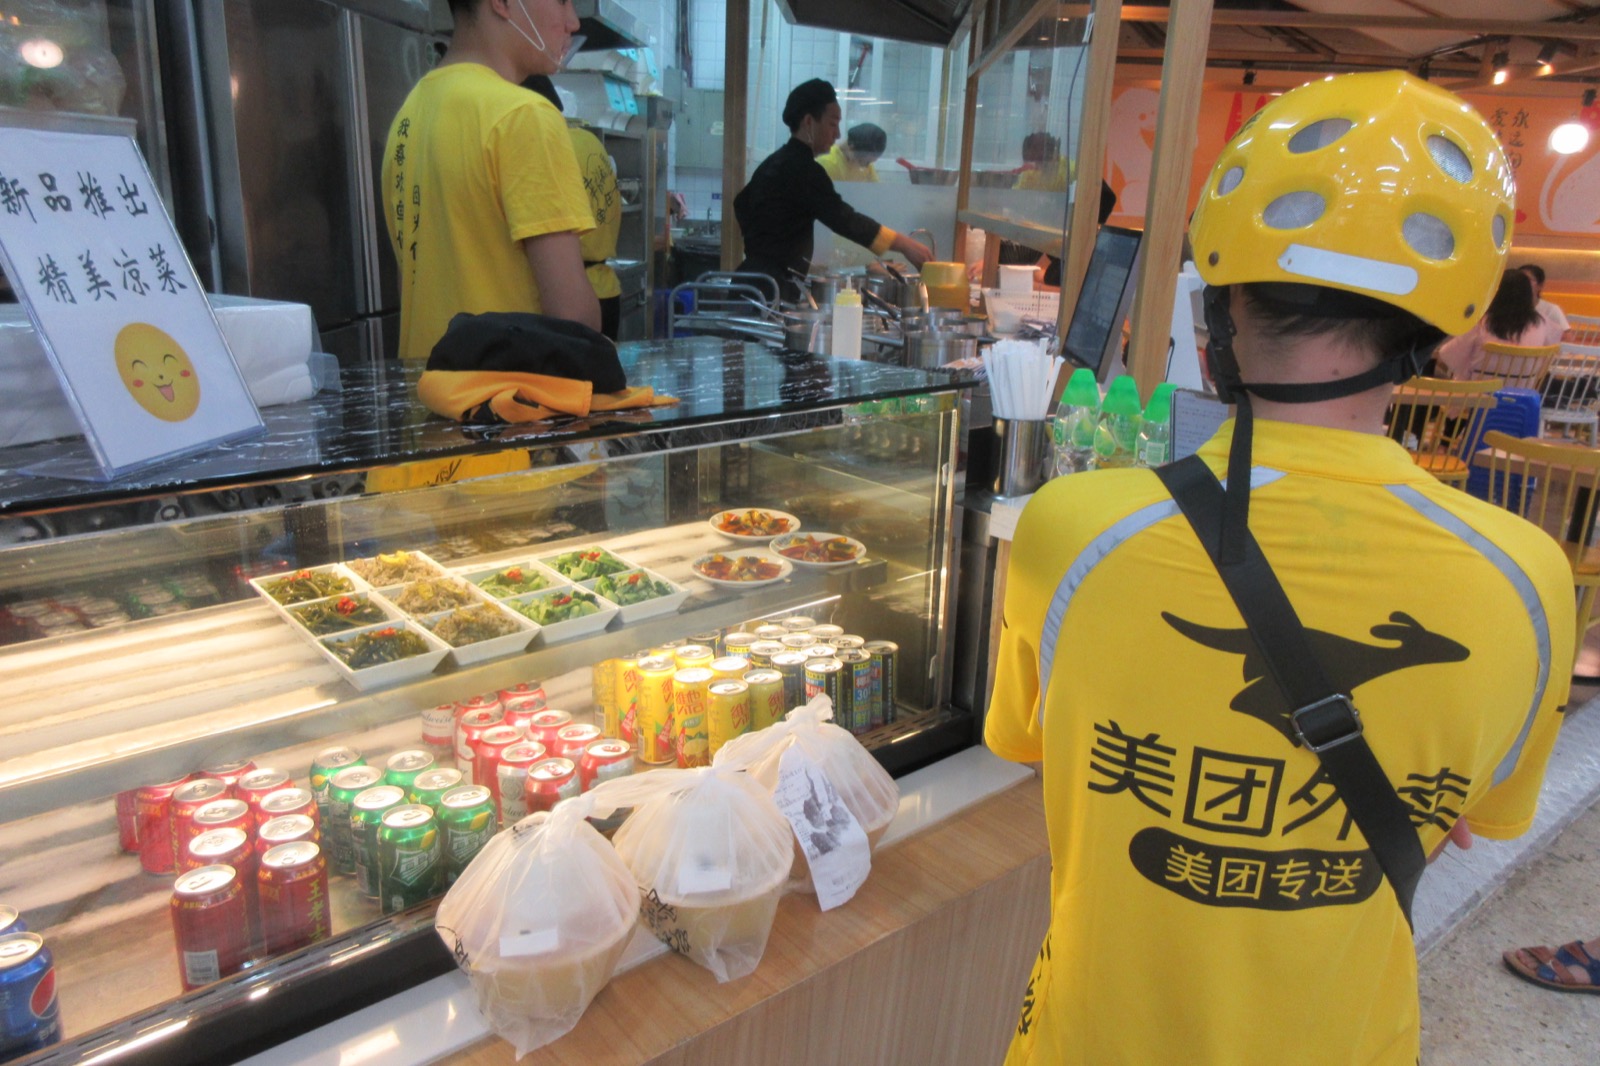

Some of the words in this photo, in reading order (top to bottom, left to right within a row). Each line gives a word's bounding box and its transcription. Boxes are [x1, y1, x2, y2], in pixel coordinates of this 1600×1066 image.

[0, 171, 149, 224] 新品推出
[38, 243, 188, 304] 精美凉菜
[1164, 844, 1363, 901] 美团专送
